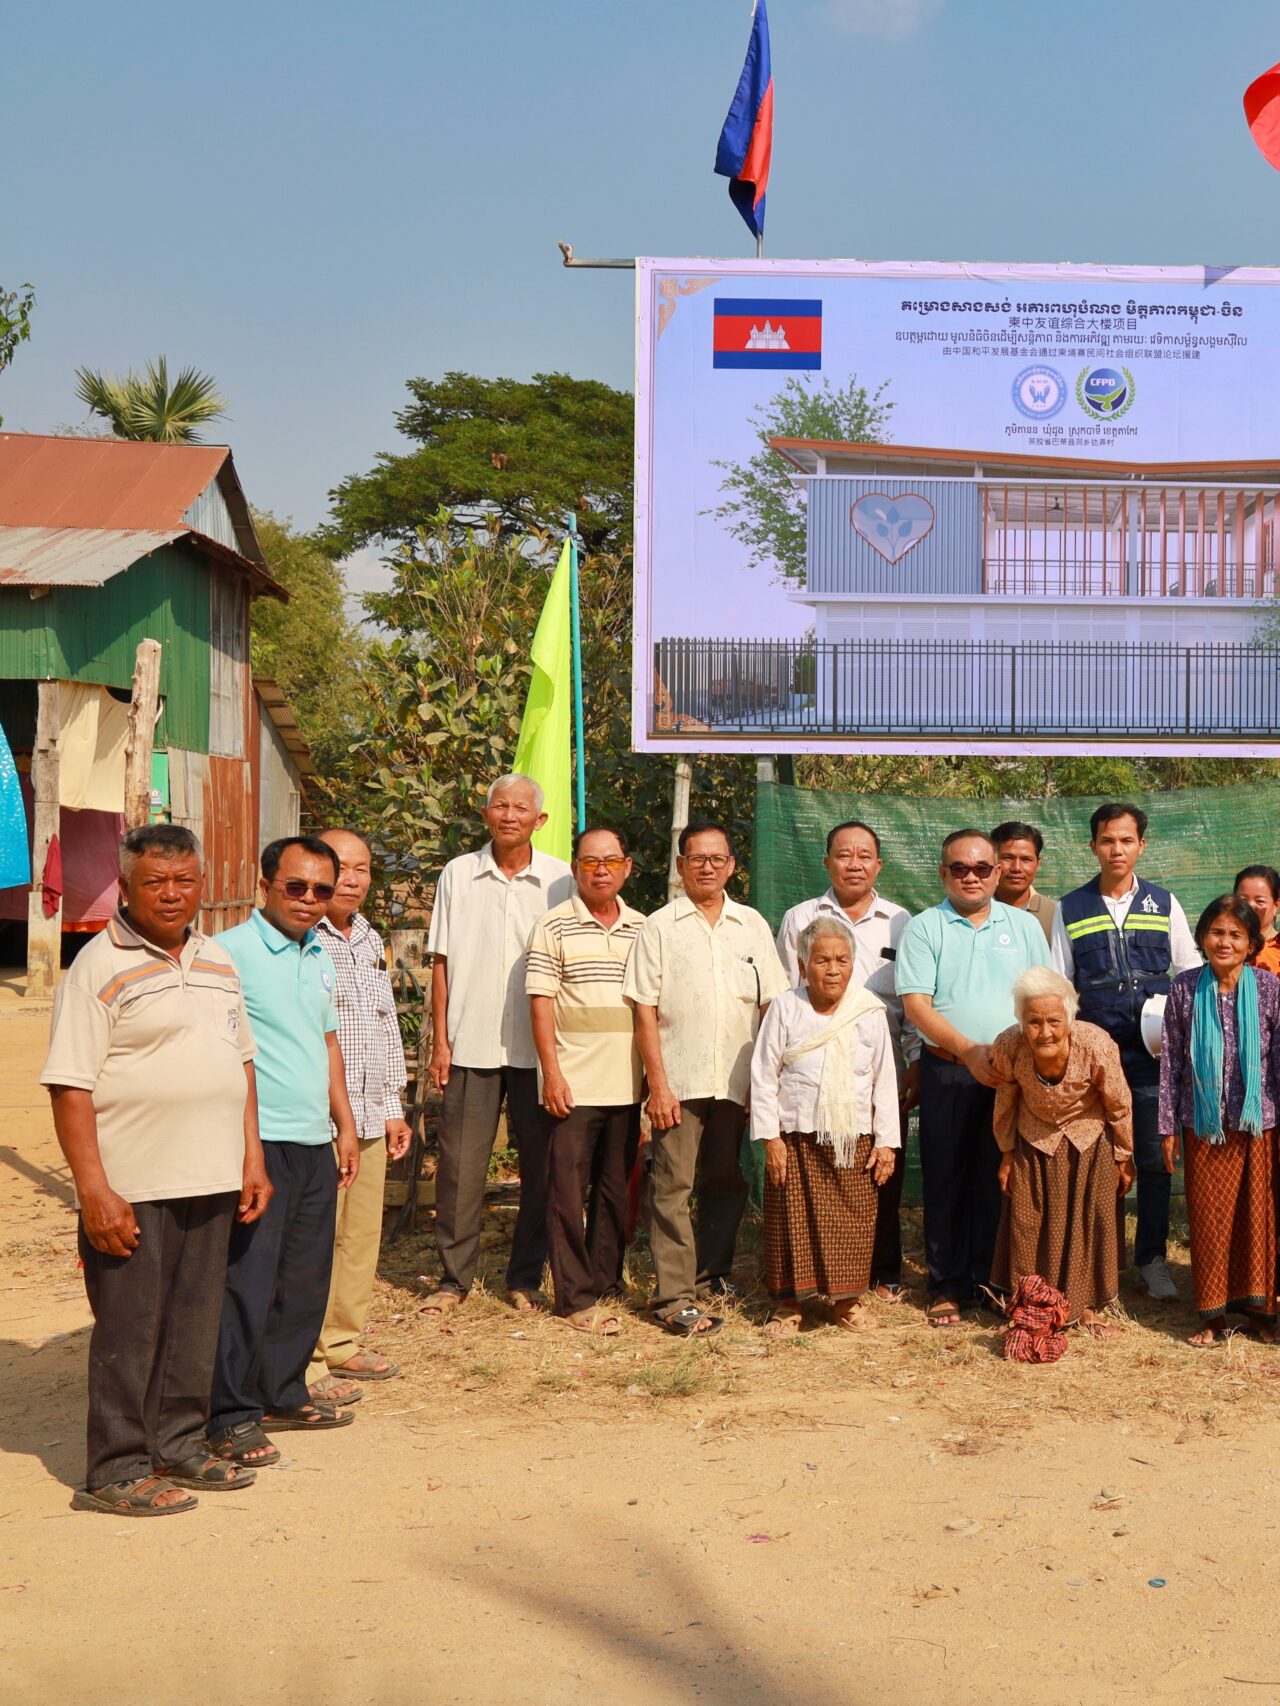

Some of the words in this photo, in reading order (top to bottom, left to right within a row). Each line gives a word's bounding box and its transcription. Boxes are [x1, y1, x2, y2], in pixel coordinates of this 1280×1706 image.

[1008, 316, 1137, 331] 柬中友谊综合大楼项目
[1090, 378, 1116, 387] CFPD
